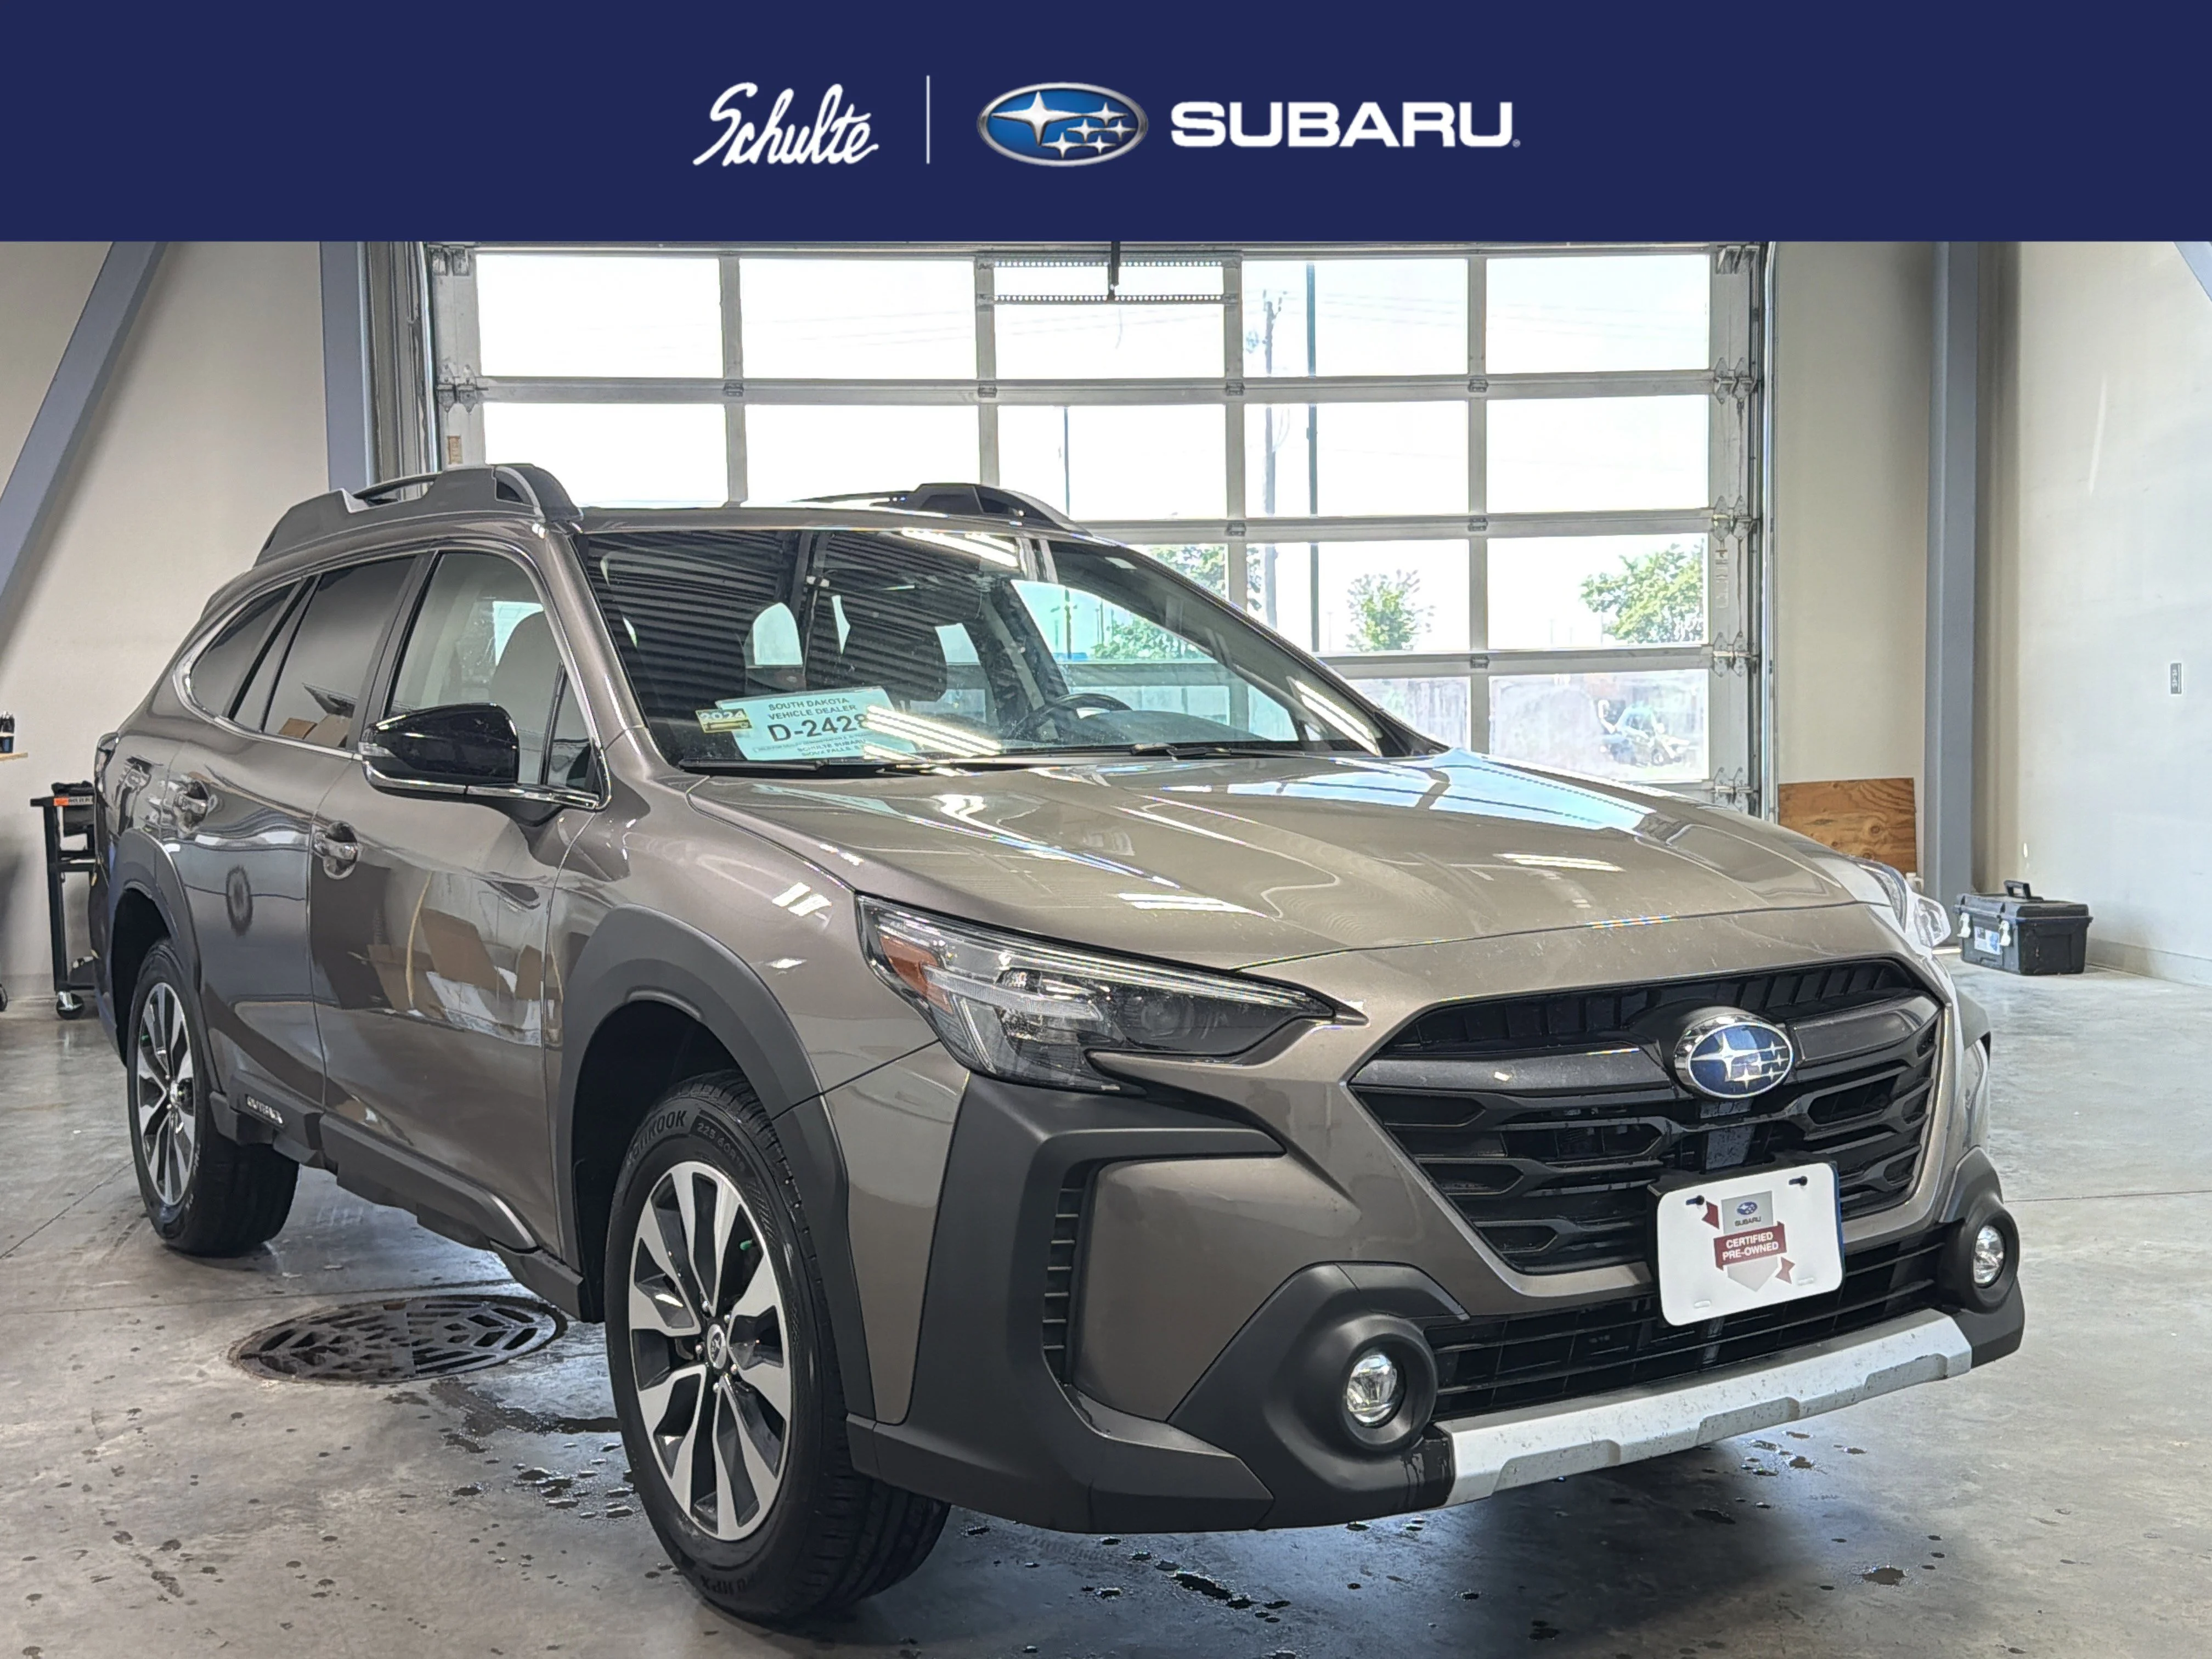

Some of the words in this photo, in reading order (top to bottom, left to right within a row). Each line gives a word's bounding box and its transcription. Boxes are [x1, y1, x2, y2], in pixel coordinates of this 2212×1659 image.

[769, 701, 805, 711] SOUTH
[806, 697, 850, 707] DAKOTA
[699, 710, 747, 721] 2024
[768, 709, 814, 720] VEHICLE
[815, 704, 857, 715] DEALER
[1734, 1216, 1761, 1226] SUBARU
[1725, 1232, 1774, 1249] CERTIFIED
[1722, 1241, 1779, 1261] PRE-OWNED
